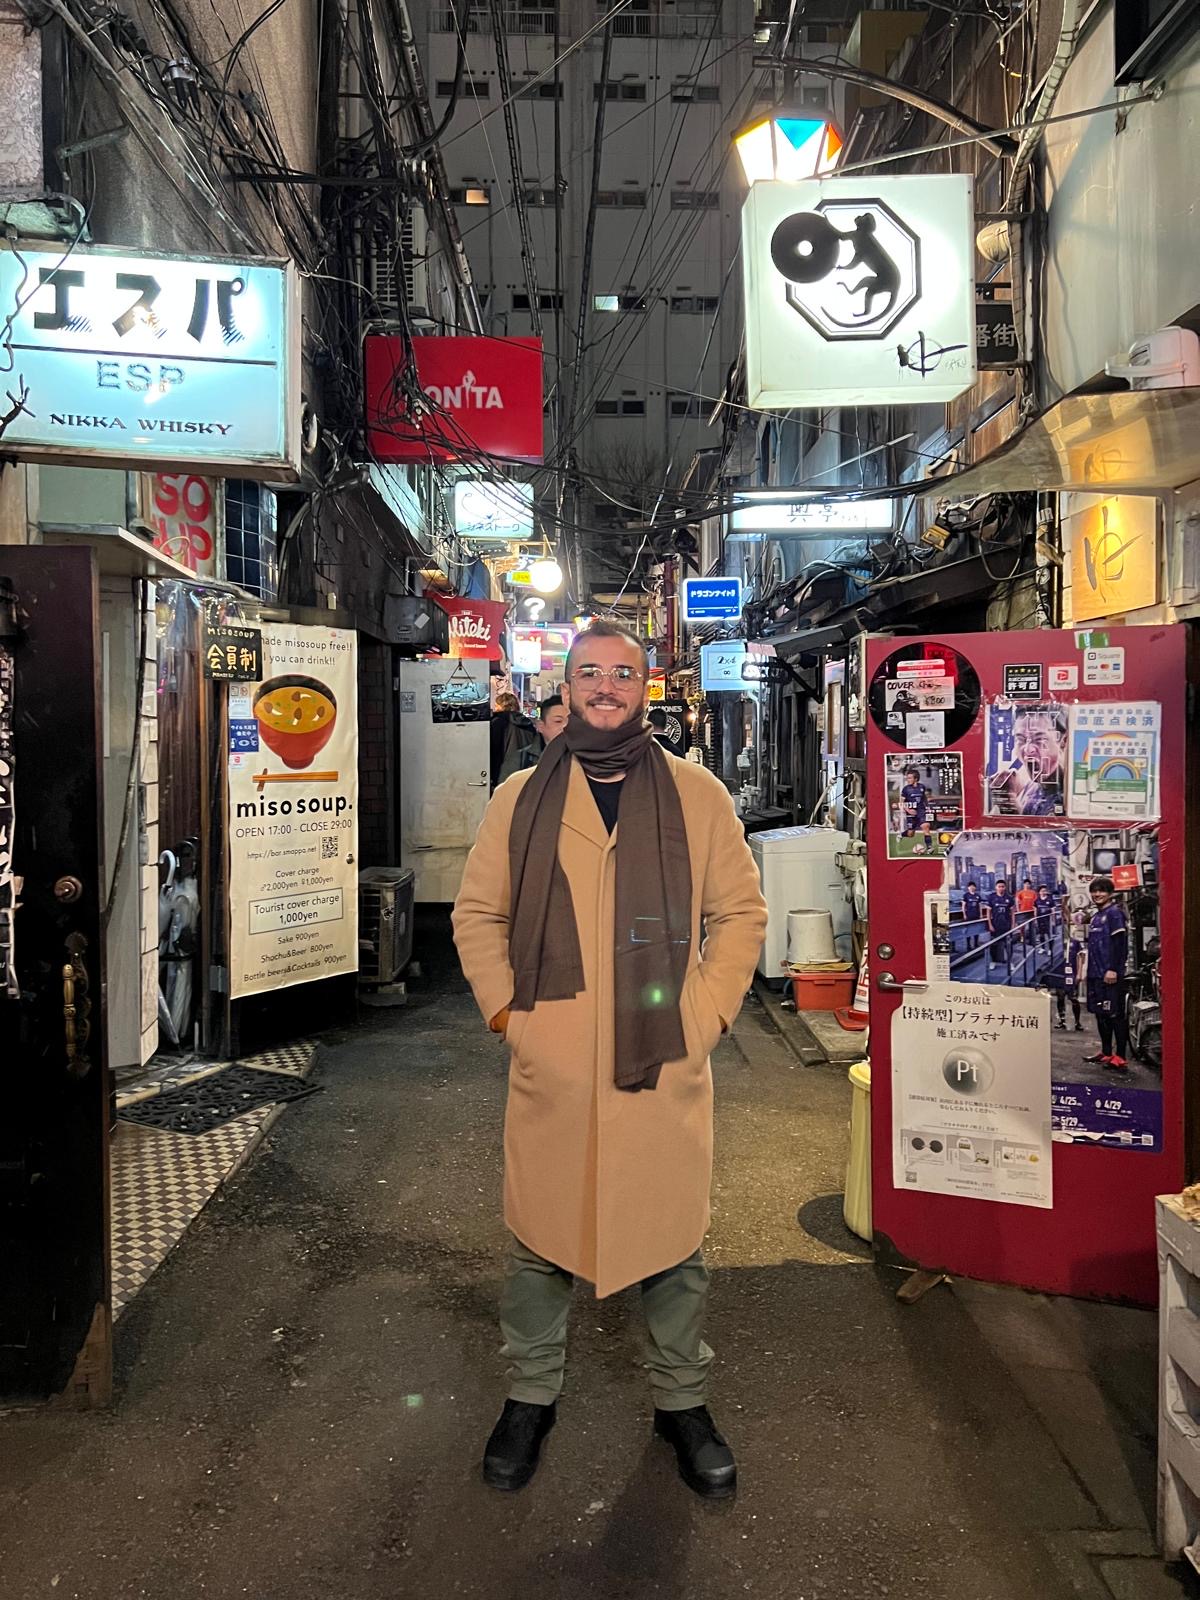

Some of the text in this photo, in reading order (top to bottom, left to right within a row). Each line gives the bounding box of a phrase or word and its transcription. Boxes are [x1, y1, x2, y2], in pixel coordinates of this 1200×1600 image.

[34, 267, 245, 346] エスパ
[97, 360, 185, 392] ESP
[424, 373, 504, 409] ONITA
[50, 413, 233, 436] NIKKA WHISKY
[285, 638, 327, 651] misosoup
[329, 641, 353, 651] free!!
[207, 643, 256, 672] 会員制
[269, 655, 286, 664] you
[289, 656, 305, 664] can
[307, 655, 336, 665] drink!!
[887, 681, 915, 690] COVER
[236, 827, 265, 838] OPEN
[268, 824, 292, 835] 17:00
[300, 821, 328, 833] CLOSE
[330, 819, 352, 830] 29:00
[276, 867, 320, 878] Cover charge
[254, 895, 340, 915] Tourist cover charge
[279, 911, 319, 925] 1,000yen
[278, 931, 320, 945] Sake 900yen
[244, 973, 266, 982] Bottle
[945, 994, 992, 1006] このお店は
[936, 1027, 1000, 1041] 施工済みです
[957, 1059, 978, 1083] Pt
